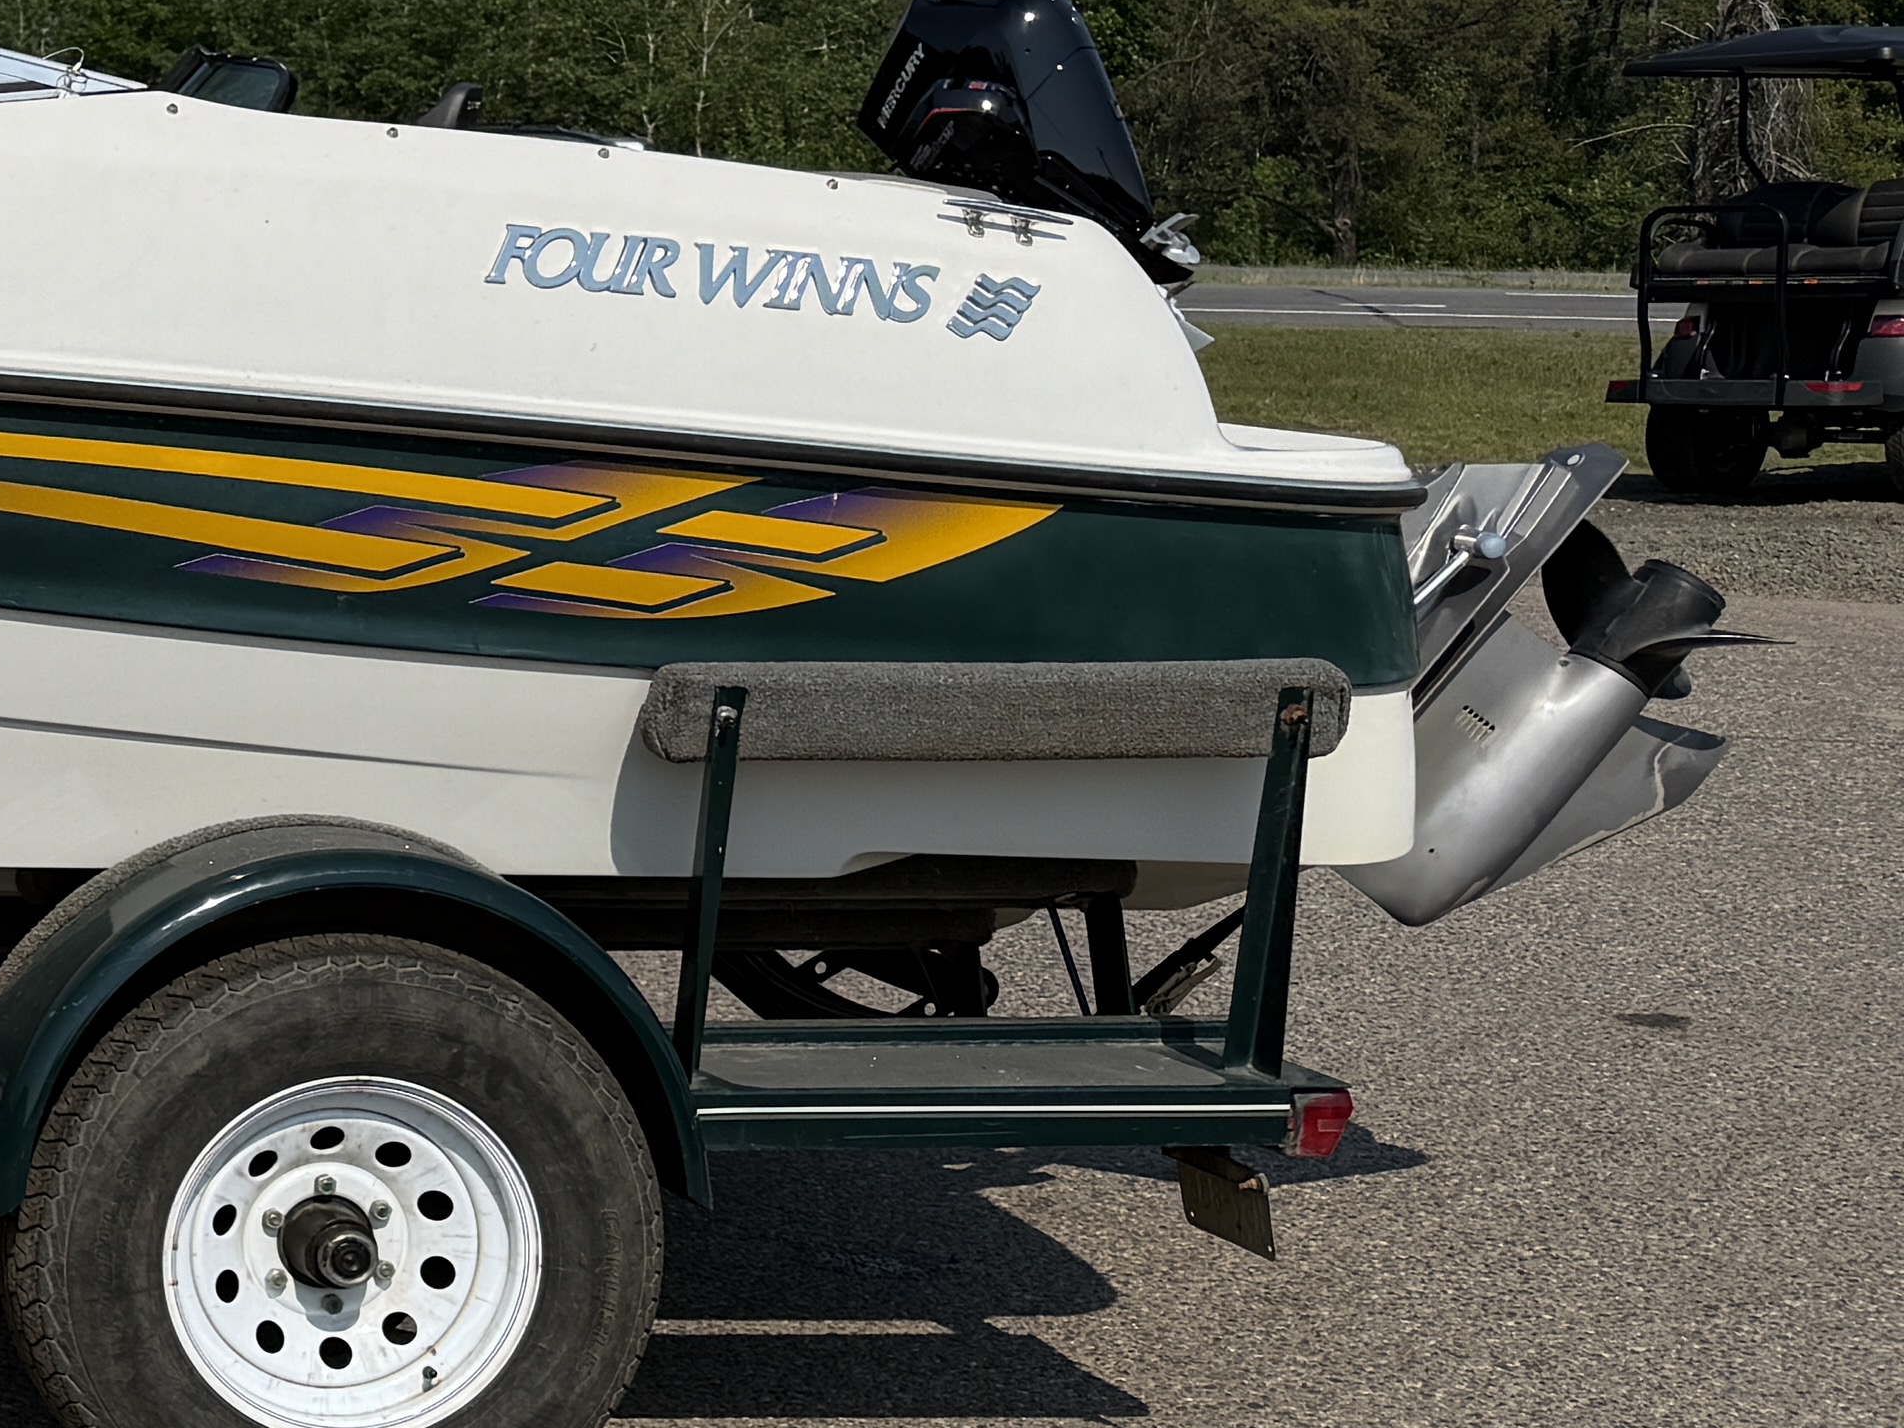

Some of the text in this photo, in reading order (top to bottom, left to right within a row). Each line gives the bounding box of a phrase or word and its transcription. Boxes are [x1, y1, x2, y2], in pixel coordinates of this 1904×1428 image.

[876, 42, 926, 130] MERCURY
[483, 223, 941, 324] FOUR WINNS
